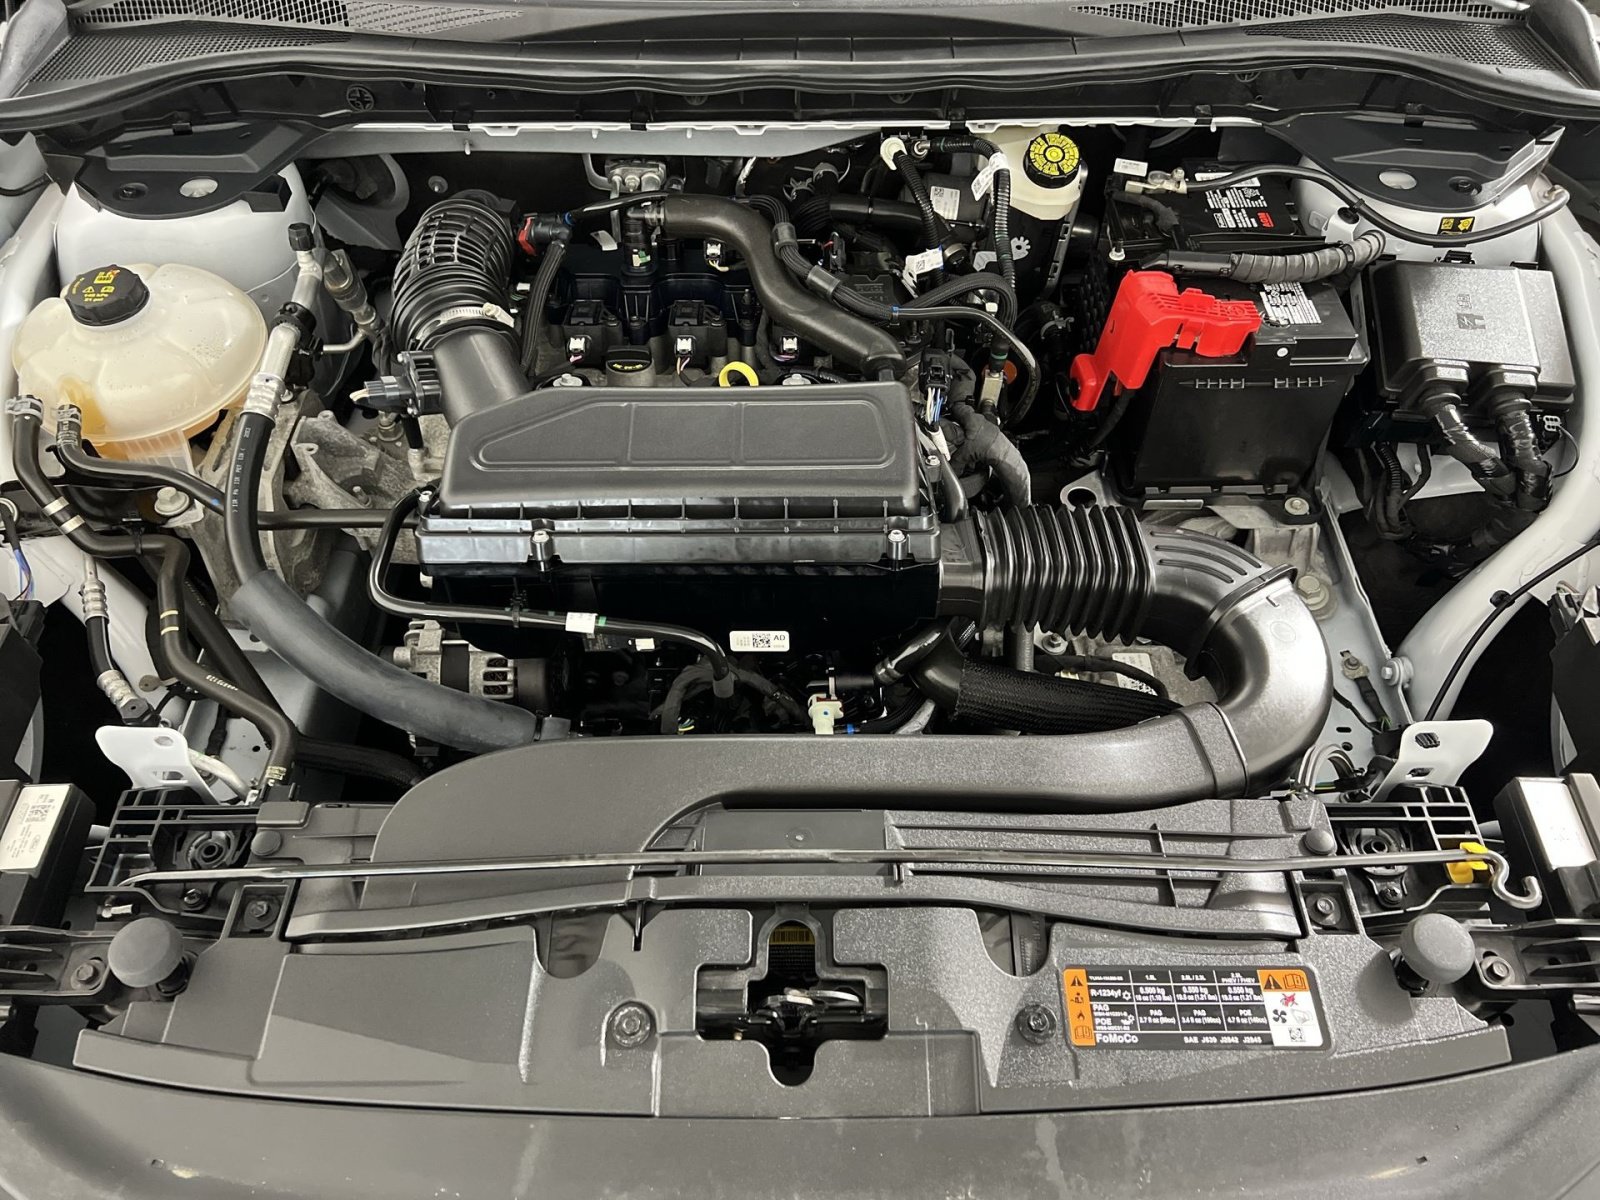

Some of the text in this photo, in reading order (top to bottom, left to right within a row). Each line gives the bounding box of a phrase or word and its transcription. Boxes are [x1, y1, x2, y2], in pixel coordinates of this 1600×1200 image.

[1090, 988, 1122, 999] R-1234yf
[1156, 987, 1166, 996] kg
[1200, 986, 1208, 995] kg
[1245, 986, 1254, 995] kg
[1095, 1034, 1139, 1043] FoMoCo
